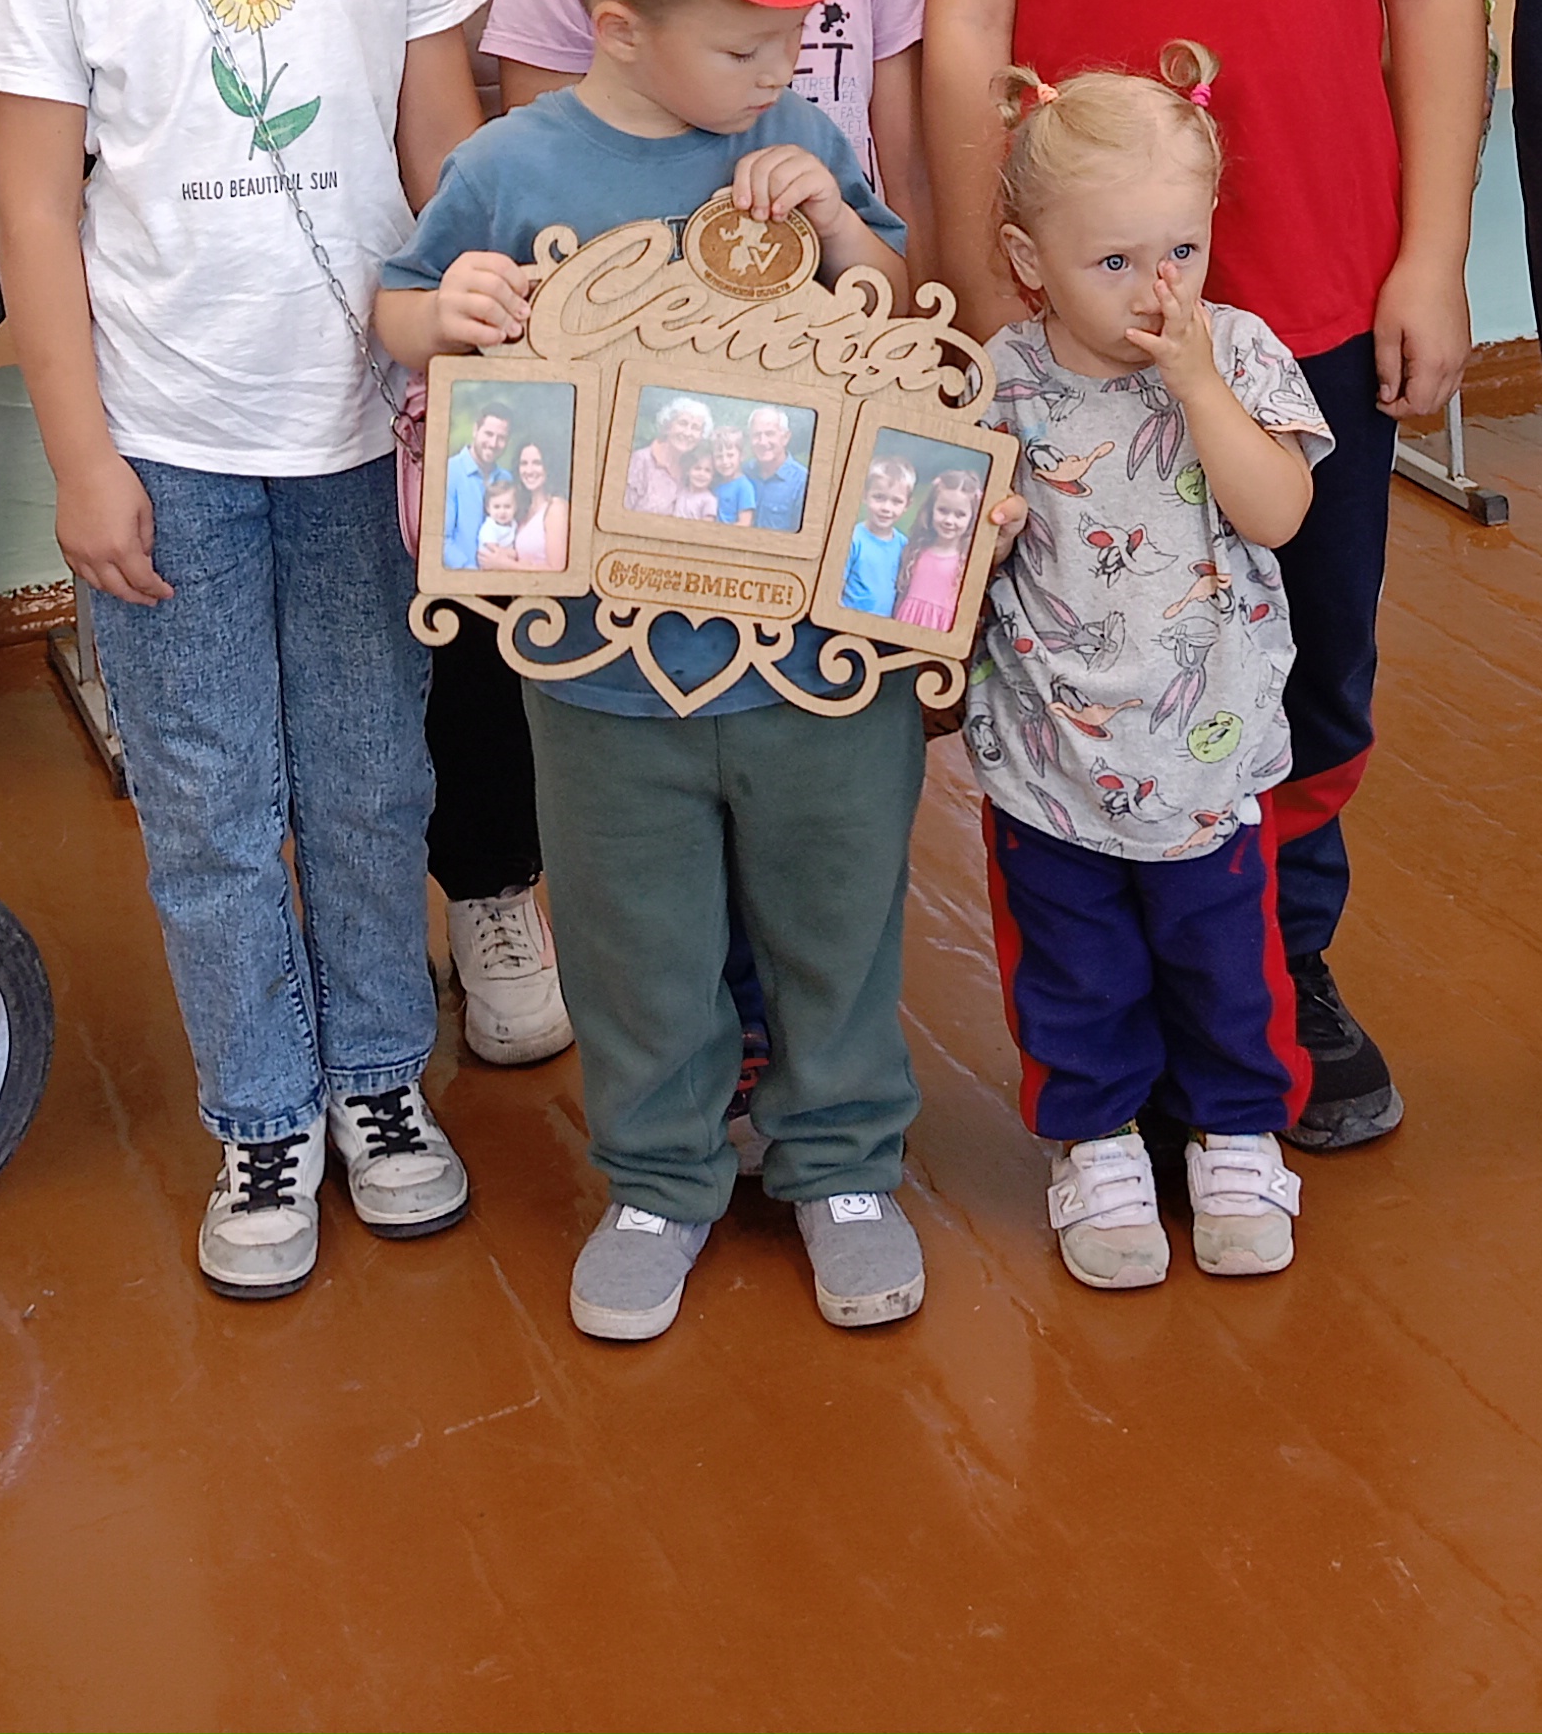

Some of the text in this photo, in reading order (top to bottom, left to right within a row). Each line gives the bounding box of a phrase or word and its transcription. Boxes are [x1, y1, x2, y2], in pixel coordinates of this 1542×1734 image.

[181, 171, 338, 201] HELLO BEAUTIFUL SUN
[609, 572, 682, 593] будущее
[684, 572, 795, 606] ВМЕСТЕ!
